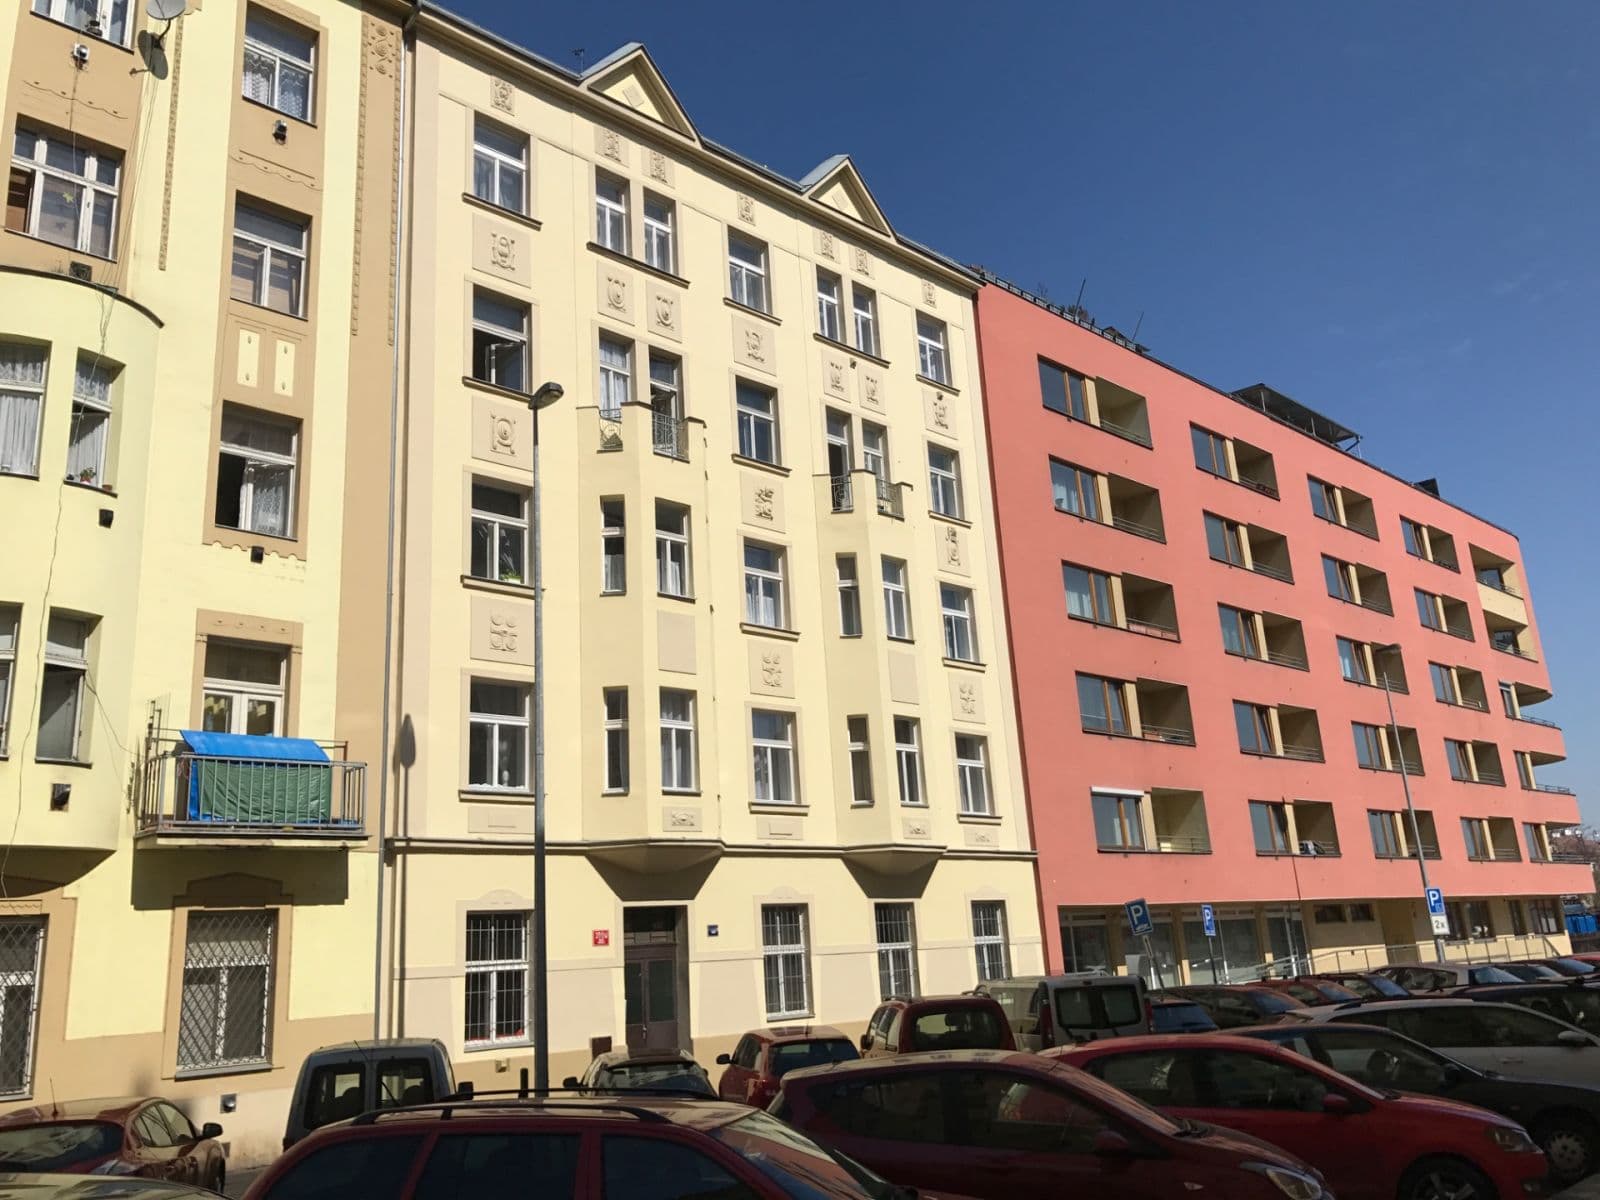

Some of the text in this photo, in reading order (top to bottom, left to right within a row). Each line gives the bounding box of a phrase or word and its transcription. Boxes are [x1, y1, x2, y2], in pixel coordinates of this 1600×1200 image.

[1429, 891, 1439, 906] P
[1130, 905, 1143, 925] P
[1205, 909, 1211, 925] P
